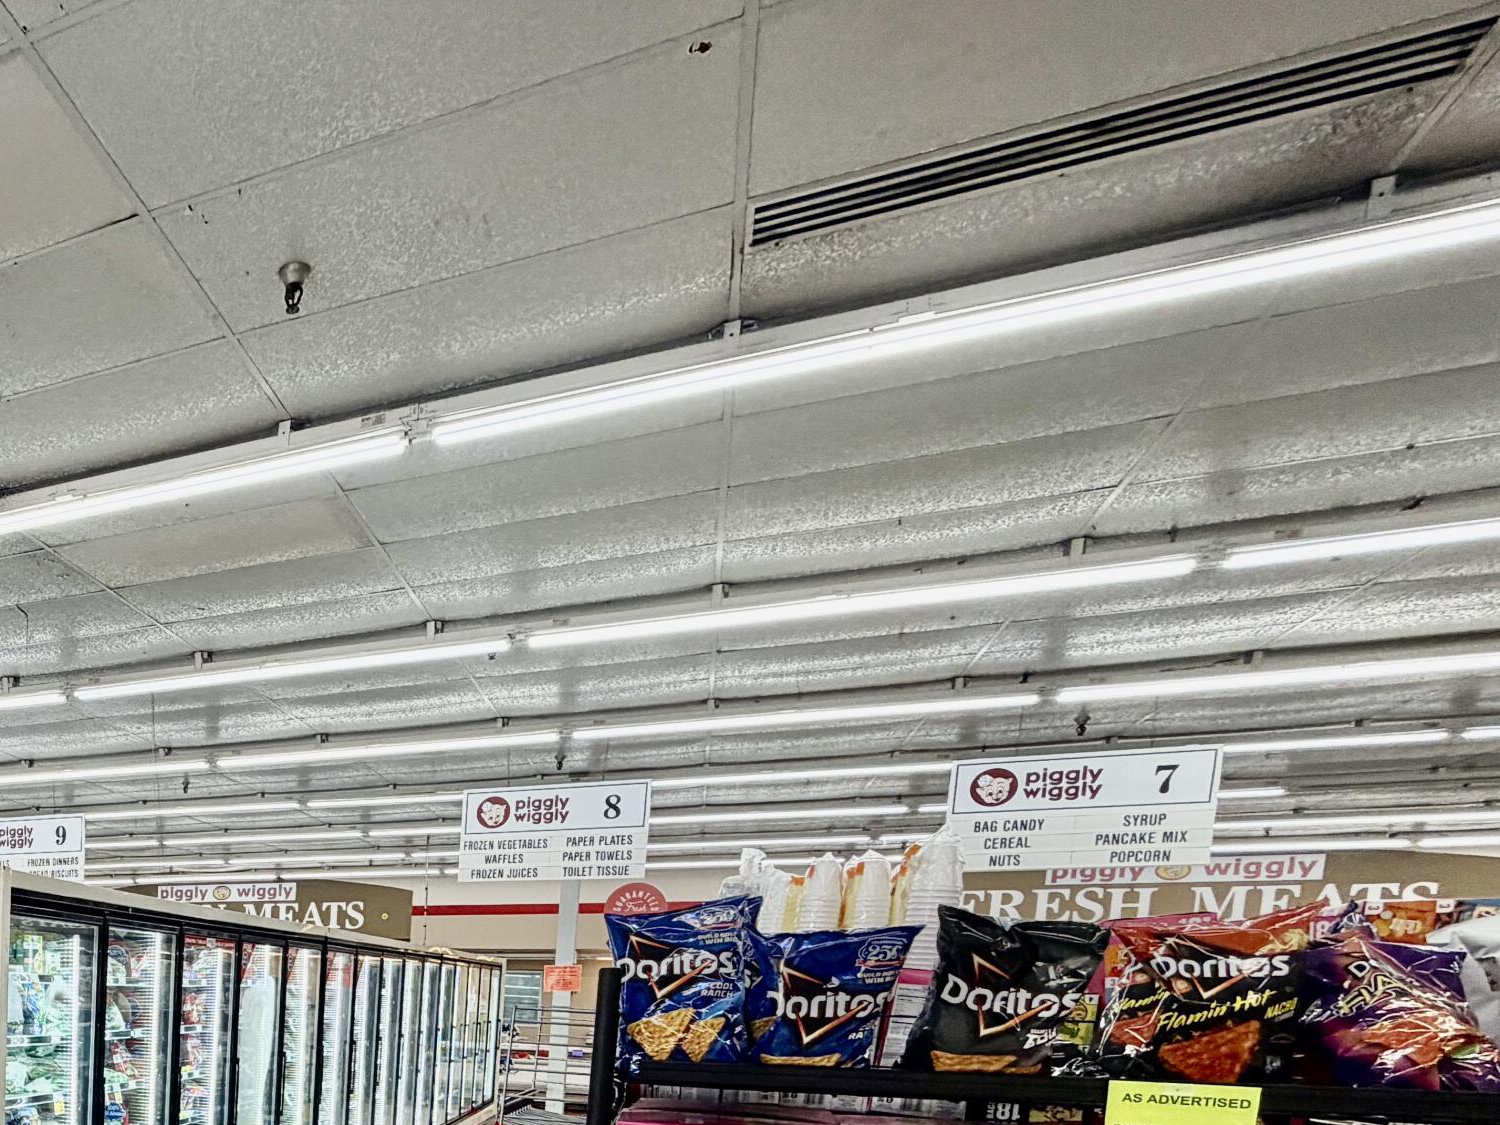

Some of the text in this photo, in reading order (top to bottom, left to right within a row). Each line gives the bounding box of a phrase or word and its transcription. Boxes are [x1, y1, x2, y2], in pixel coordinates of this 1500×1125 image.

[1024, 766, 1103, 786] piggly
[1154, 765, 1180, 794] 7
[1022, 783, 1102, 800] wiggly
[515, 795, 570, 811] piggly
[603, 794, 622, 819] 8
[513, 809, 570, 824] wiggly
[1123, 814, 1167, 827] SYRUP
[973, 818, 1044, 833] BAG CANDY
[55, 825, 67, 846] 9
[566, 834, 633, 847] PAPER PLATES
[984, 836, 1031, 849] CEREAL
[1095, 830, 1187, 846] PANCAKE MIX
[464, 839, 548, 851] FROZEN VEGETABLES
[28, 856, 79, 867] FROZEN DINNERS
[484, 853, 524, 864] WAFFLES
[562, 850, 633, 862] PAPER TOWELS
[989, 854, 1020, 867] NUTS
[1109, 849, 1171, 864] POPCORN
[470, 867, 538, 879] FROZEN JUICES
[563, 865, 630, 877] TOILET TISSUE
[1204, 855, 1318, 879] wiggly
[160, 883, 293, 902] piggly wiggly
[957, 886, 1159, 921] FRESH
[244, 901, 365, 929] MEATS
[617, 950, 734, 984] Doritos
[1151, 954, 1290, 980] Doritos
[700, 989, 735, 999] RANCH
[940, 973, 1080, 1020] Doritos
[1232, 989, 1275, 1011] Hot
[1122, 1093, 1252, 1109] AS ADVERTISED
